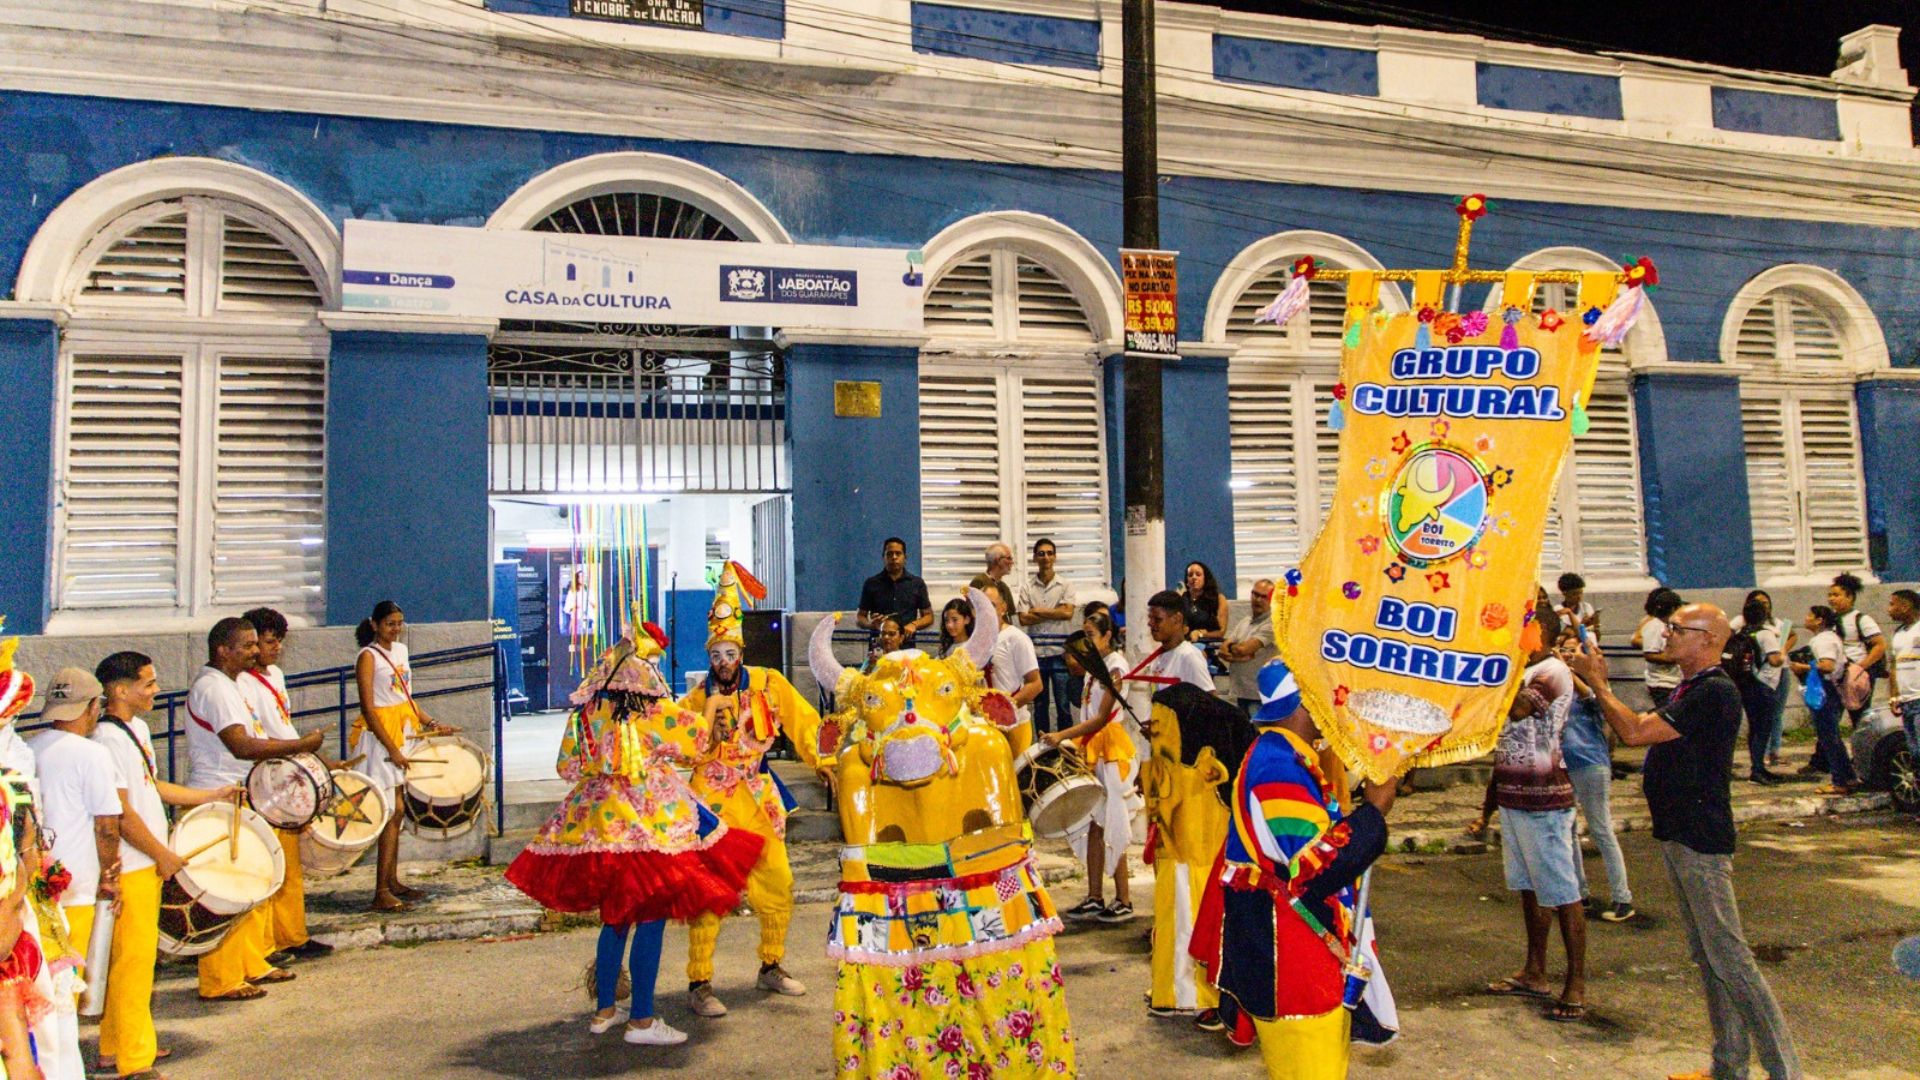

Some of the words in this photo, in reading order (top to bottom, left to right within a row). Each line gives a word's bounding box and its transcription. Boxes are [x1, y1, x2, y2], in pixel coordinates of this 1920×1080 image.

[634, 11, 649, 19] DE
[652, 7, 702, 25] LACERDA
[390, 274, 433, 287] Dança
[778, 277, 851, 293] JABOATÃO
[1141, 281, 1171, 292] CARTÃO
[505, 290, 559, 305] CASA
[562, 296, 581, 306] DA
[583, 293, 671, 309] CULTURA
[781, 290, 798, 298] DOS
[799, 291, 848, 300] GUARARAPES
[1128, 299, 1142, 313] R$
[1392, 347, 1539, 379] GRUPO
[1353, 383, 1565, 419] CULTURAL
[1423, 523, 1444, 535] BOI
[1376, 596, 1457, 641] BOI
[1322, 629, 1511, 686] SORRIZO
